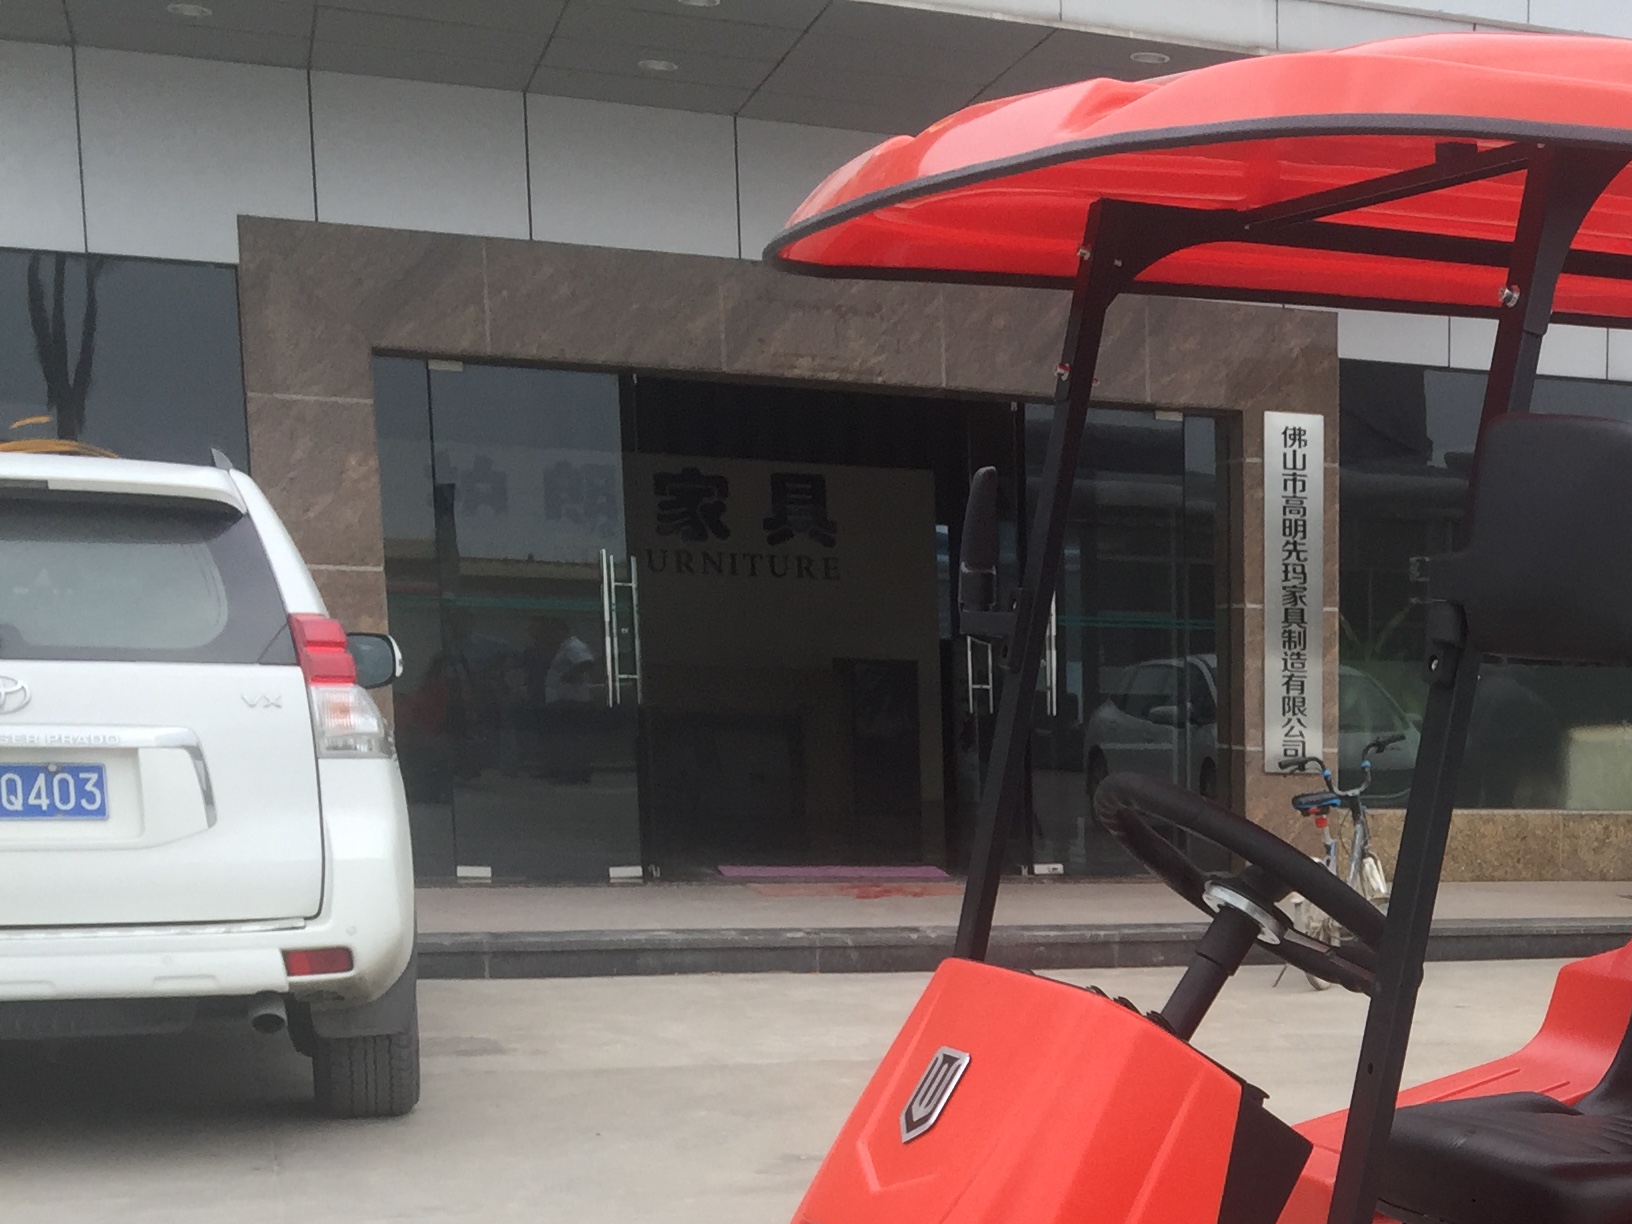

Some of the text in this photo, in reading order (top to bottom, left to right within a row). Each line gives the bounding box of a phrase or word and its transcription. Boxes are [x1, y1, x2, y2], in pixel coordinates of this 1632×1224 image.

[1281, 425, 1308, 771] 佛山市高明先玛家具制造有限公司
